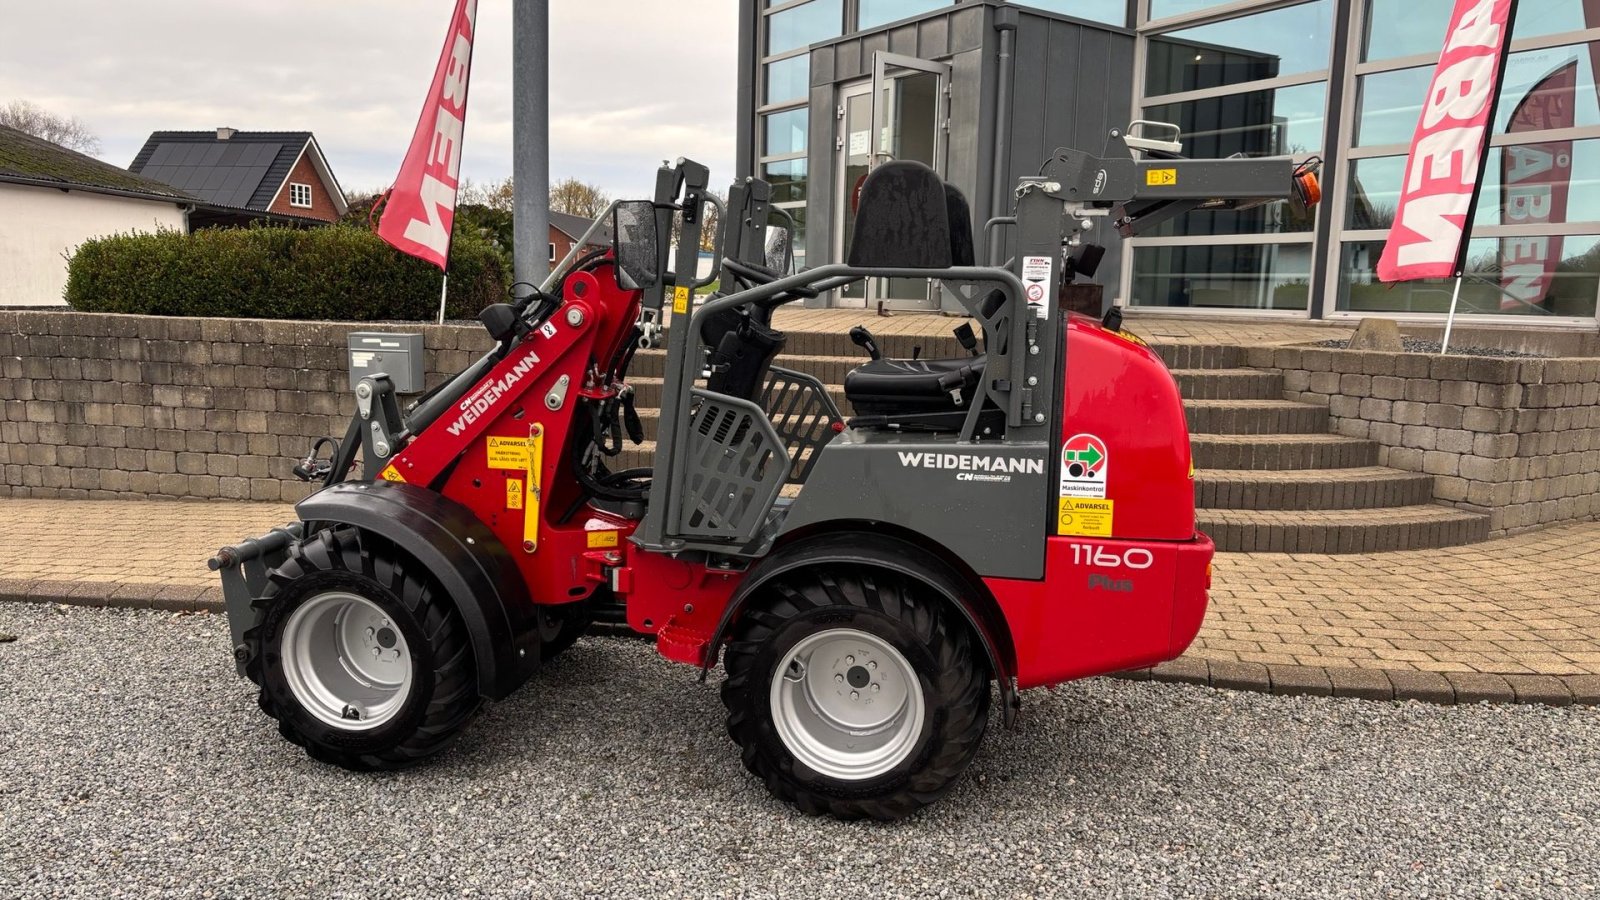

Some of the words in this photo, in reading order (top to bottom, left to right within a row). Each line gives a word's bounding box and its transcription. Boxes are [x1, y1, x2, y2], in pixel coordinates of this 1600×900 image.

[446, 351, 541, 436] WEIDEMANN
[897, 451, 1044, 475] WEIDEMANN
[1062, 485, 1104, 493] Maskinkontrol
[1075, 503, 1110, 511] ADVARSEL
[1070, 543, 1154, 570] 1160
[1087, 573, 1134, 593] Plus
